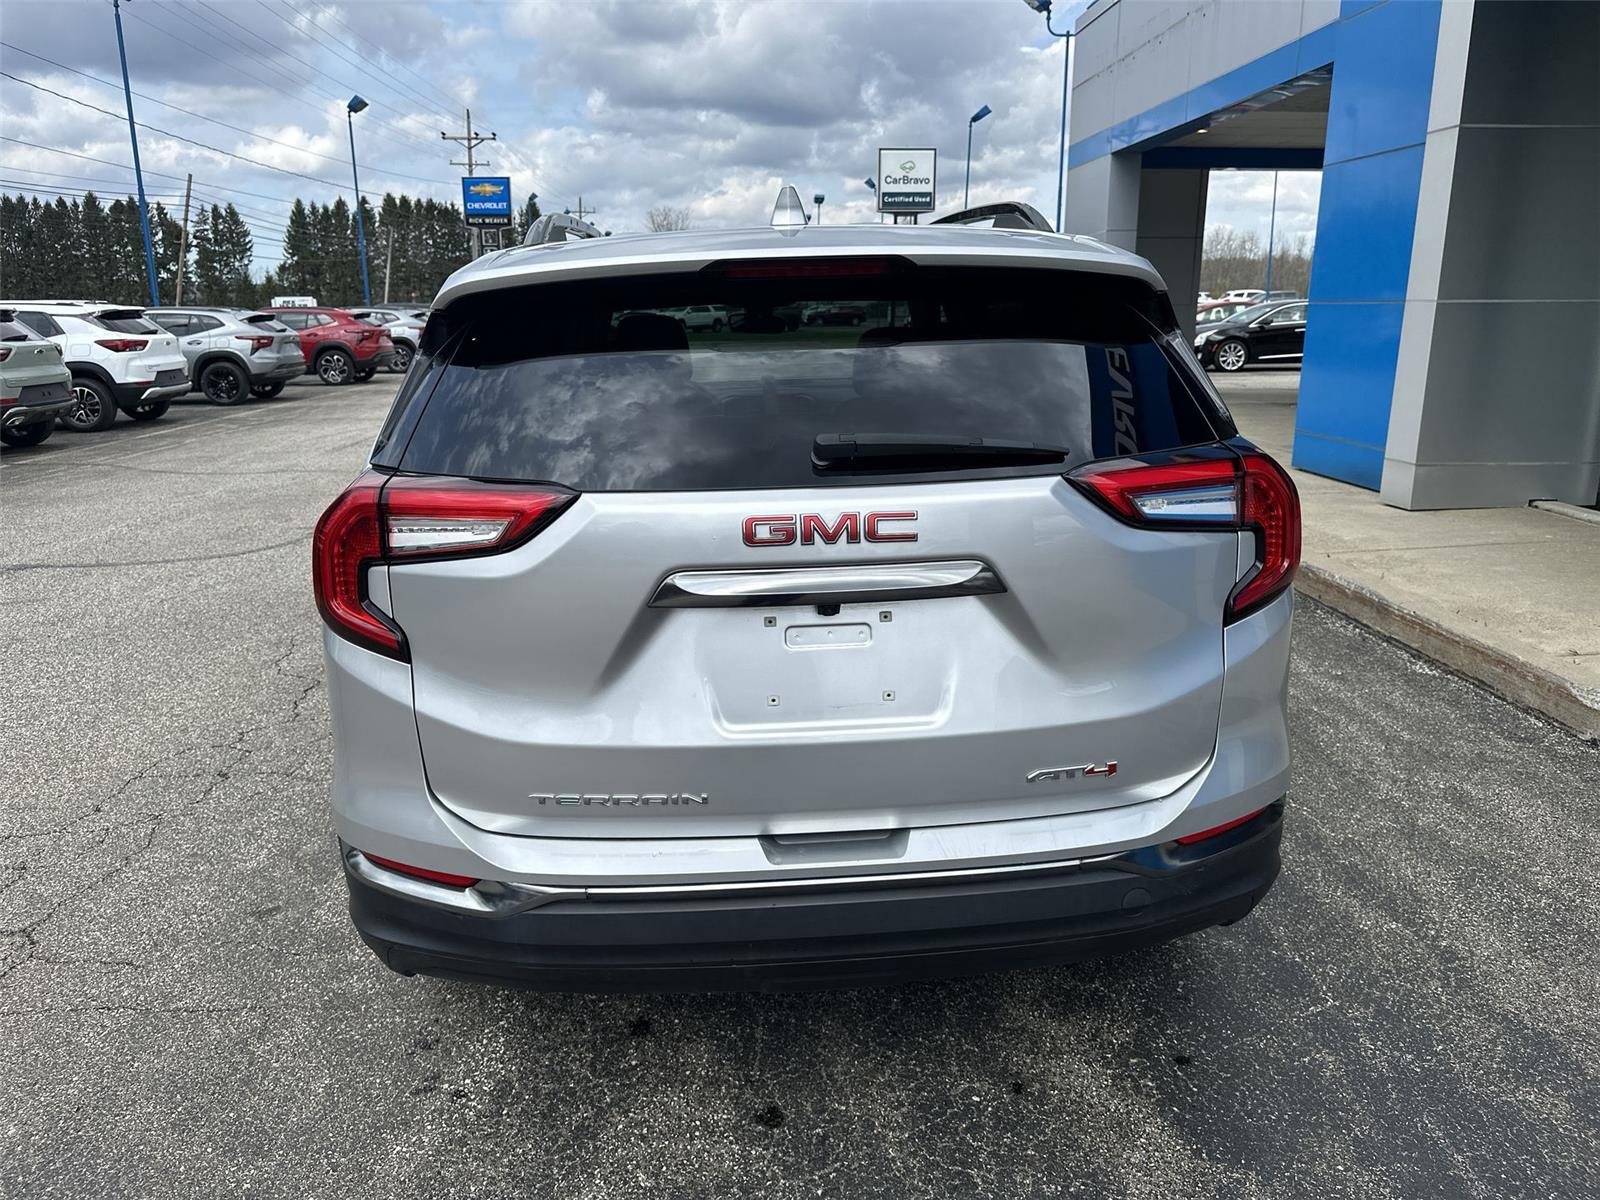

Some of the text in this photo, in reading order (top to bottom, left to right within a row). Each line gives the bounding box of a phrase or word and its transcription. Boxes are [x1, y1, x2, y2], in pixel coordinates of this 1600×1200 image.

[884, 175, 931, 185] CarBravo
[742, 511, 918, 546] GMC
[1026, 761, 1118, 782] AT4
[528, 793, 709, 806] TERRAIN
